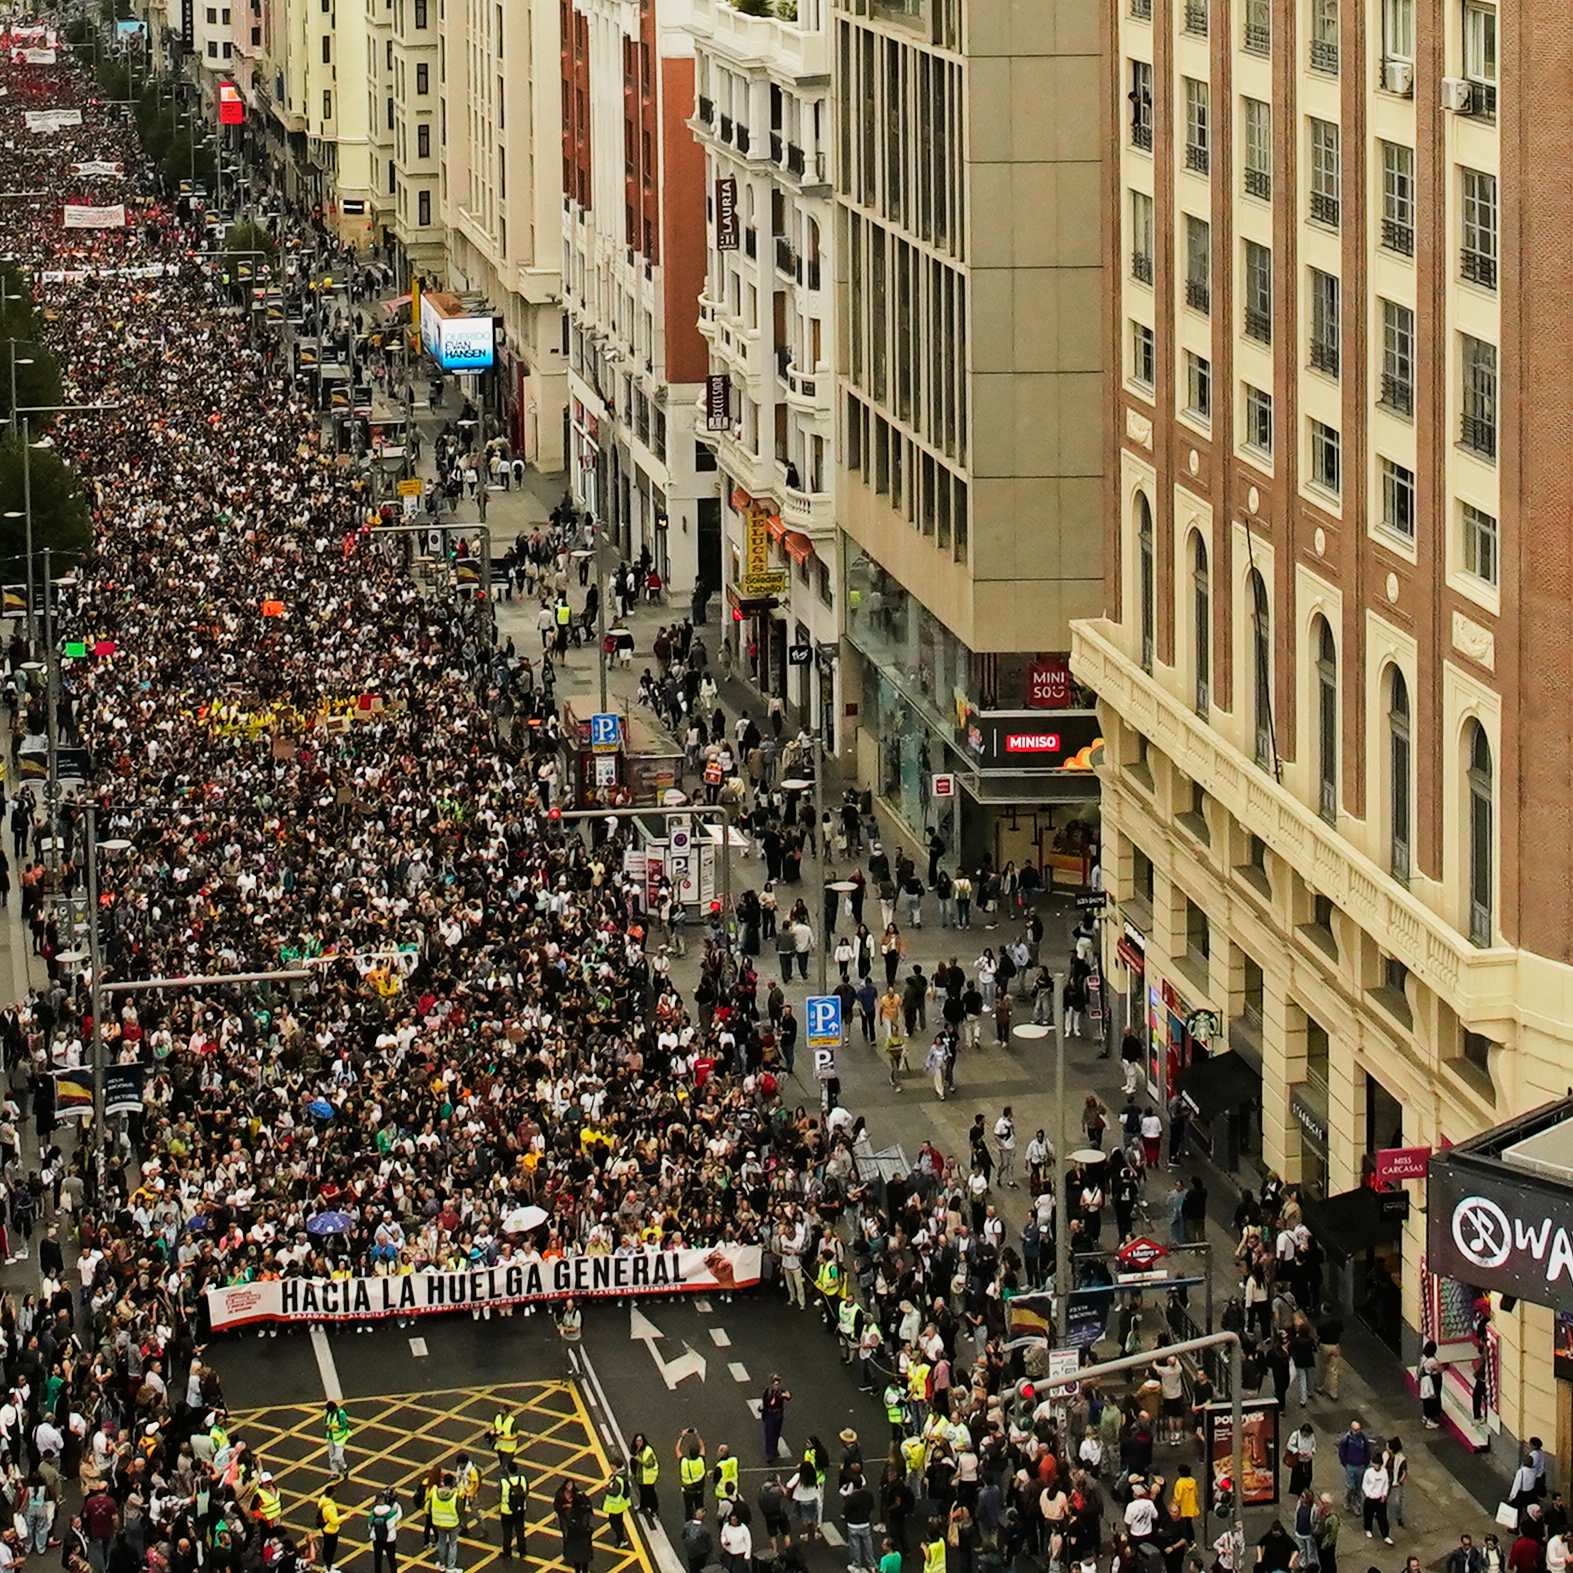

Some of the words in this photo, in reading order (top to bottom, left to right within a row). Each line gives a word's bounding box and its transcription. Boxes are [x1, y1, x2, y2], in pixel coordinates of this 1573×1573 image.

[722, 181, 733, 233] LAURIA
[445, 341, 471, 350] EVAN
[445, 349, 486, 358] HANSEN
[751, 510, 765, 573] PELUCAS
[1033, 672, 1065, 684] MINI
[597, 718, 614, 741] P
[1010, 736, 1056, 748] MINISO
[815, 1003, 835, 1032] P
[815, 1050, 832, 1071] P
[1292, 1102, 1323, 1140] STARBUCKS
[1393, 1155, 1412, 1165] MISS
[1381, 1164, 1423, 1175] CARCASAS
[1132, 1249, 1155, 1258] Metro
[282, 1279, 371, 1314] HACIA
[382, 1275, 416, 1309] LA
[428, 1262, 543, 1305] HUELGA
[554, 1252, 688, 1291] GENERAL
